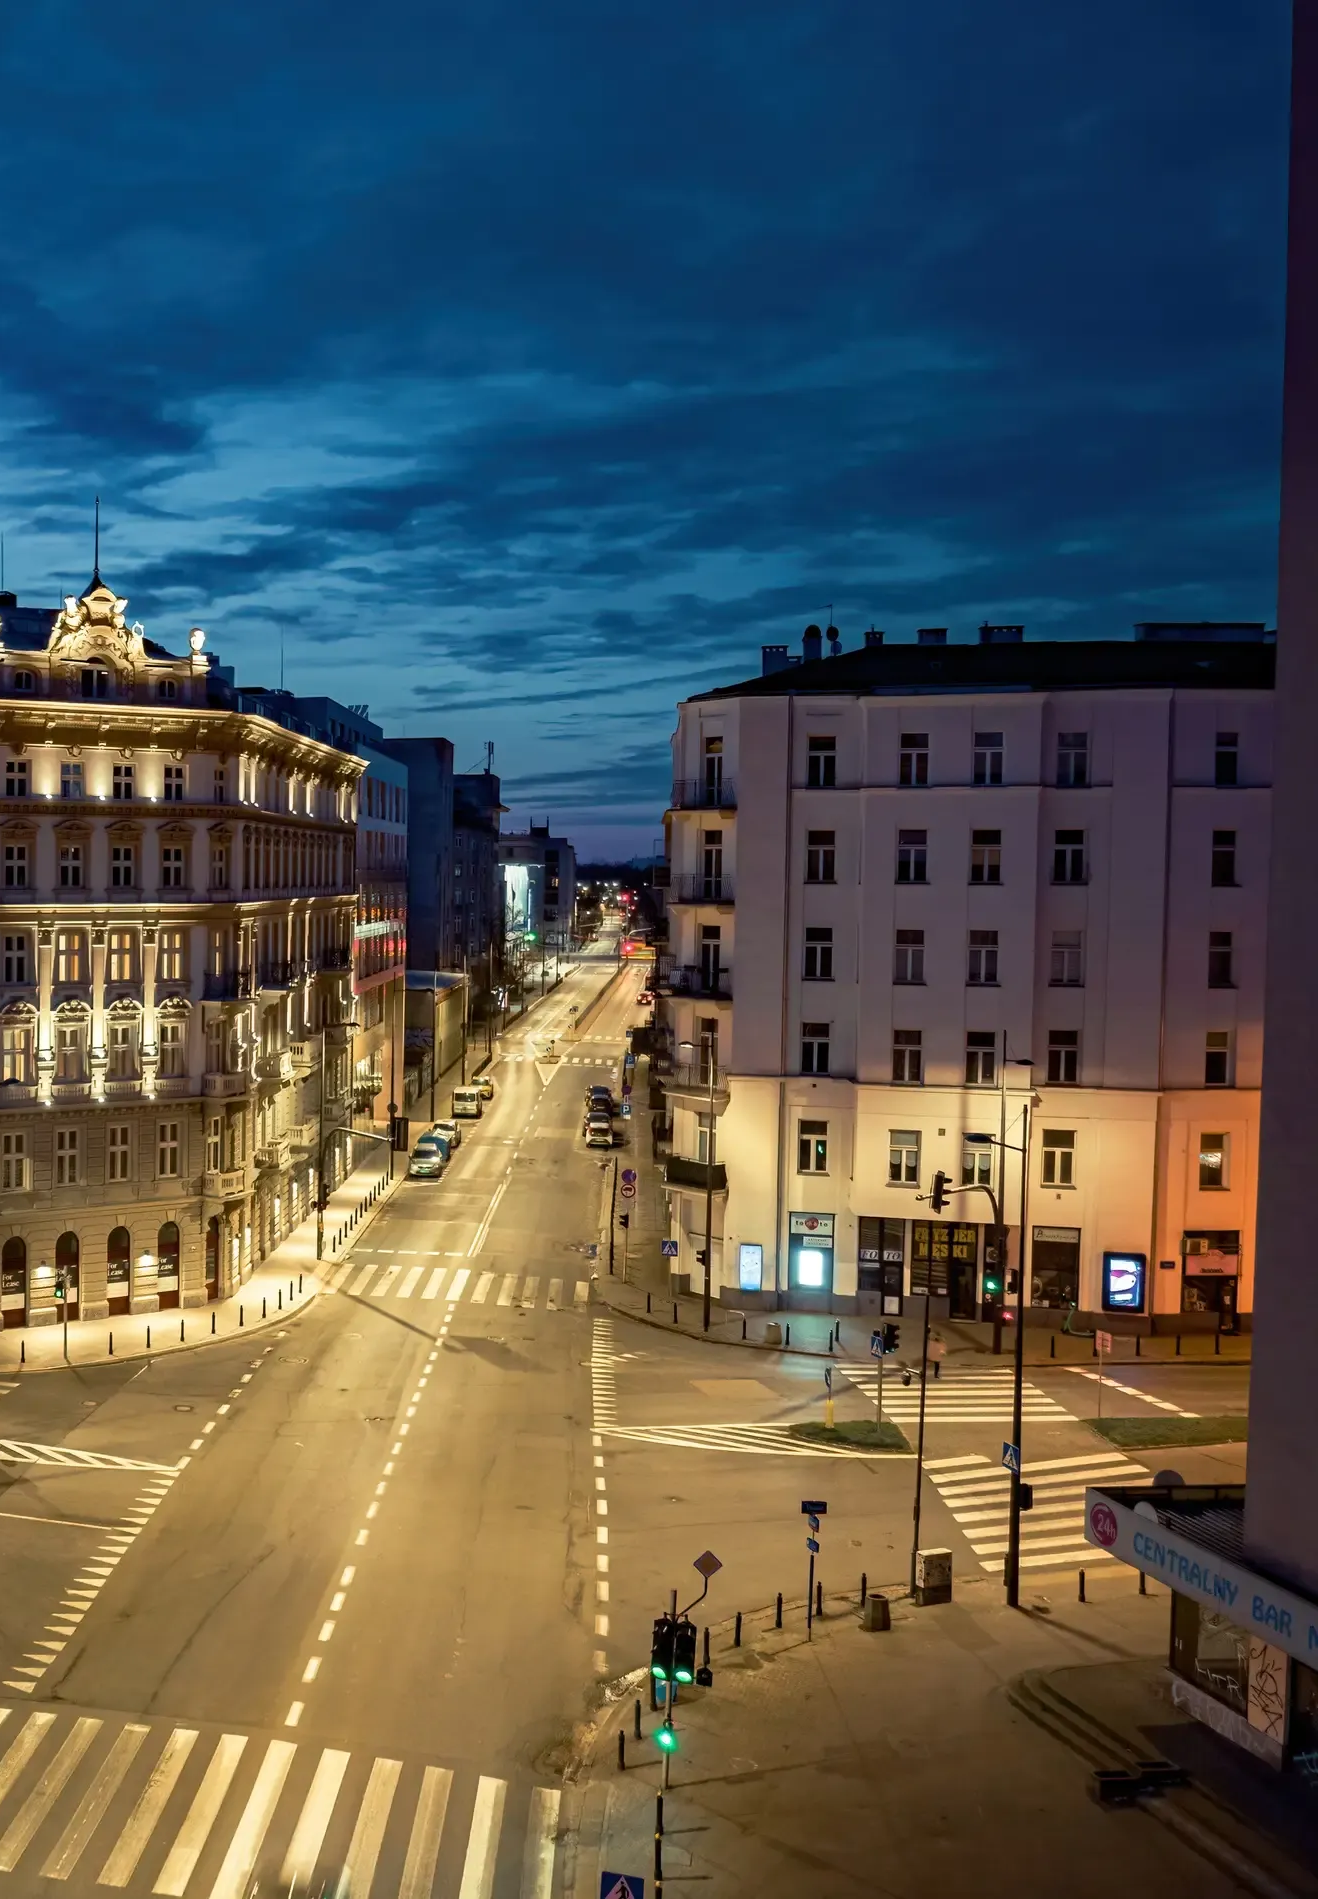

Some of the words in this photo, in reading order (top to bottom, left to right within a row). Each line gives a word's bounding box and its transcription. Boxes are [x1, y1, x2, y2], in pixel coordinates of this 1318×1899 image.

[2, 1273, 14, 1281] For
[107, 1269, 124, 1277] Lease
[2, 1280, 20, 1288] Lease
[1097, 1513, 1116, 1539] 24h
[1133, 1531, 1239, 1607] CENTRALNY
[1252, 1594, 1292, 1638] BAR
